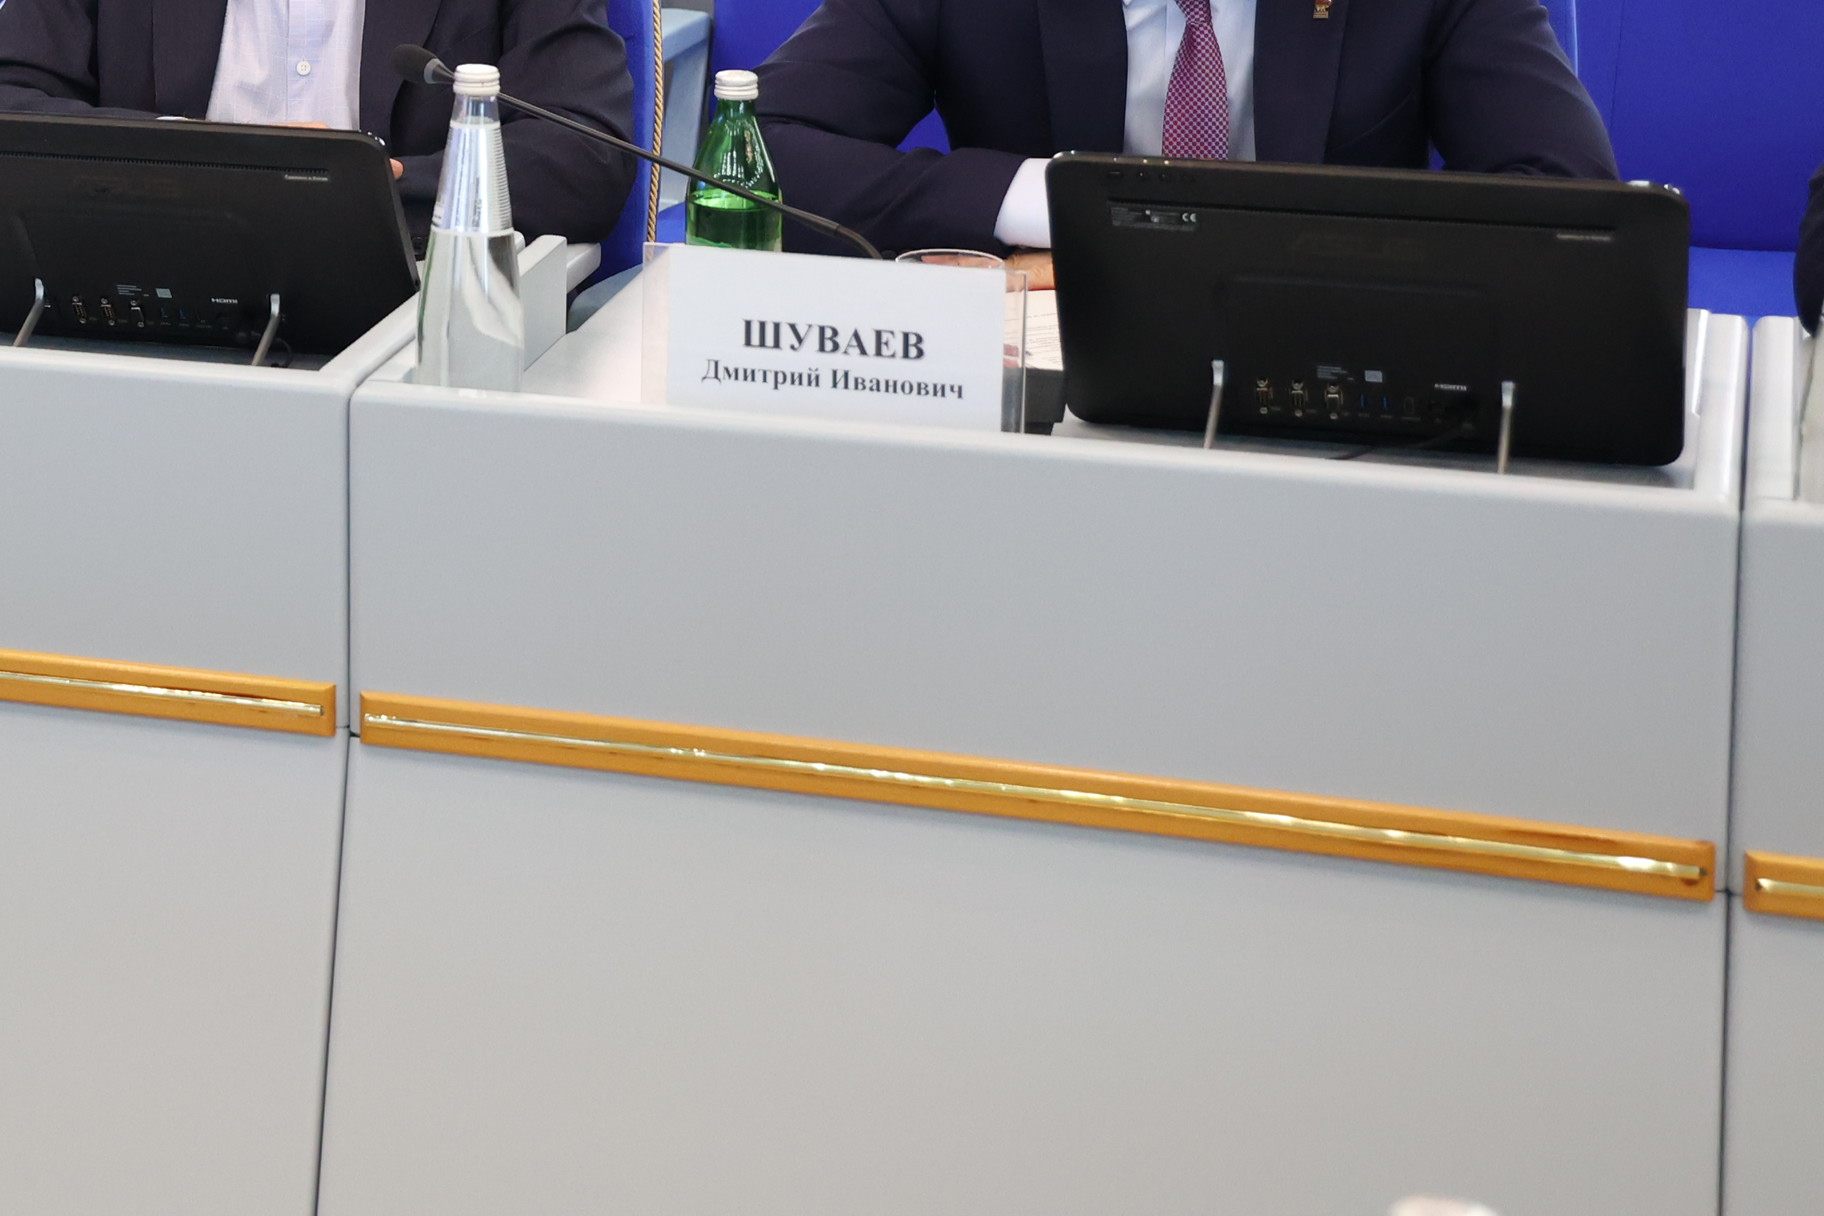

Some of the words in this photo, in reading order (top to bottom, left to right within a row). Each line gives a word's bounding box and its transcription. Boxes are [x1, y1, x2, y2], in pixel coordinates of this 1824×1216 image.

[742, 319, 925, 360] ШУВАЕВ
[701, 358, 821, 390] Дмитрий
[830, 368, 965, 400] Иванович
